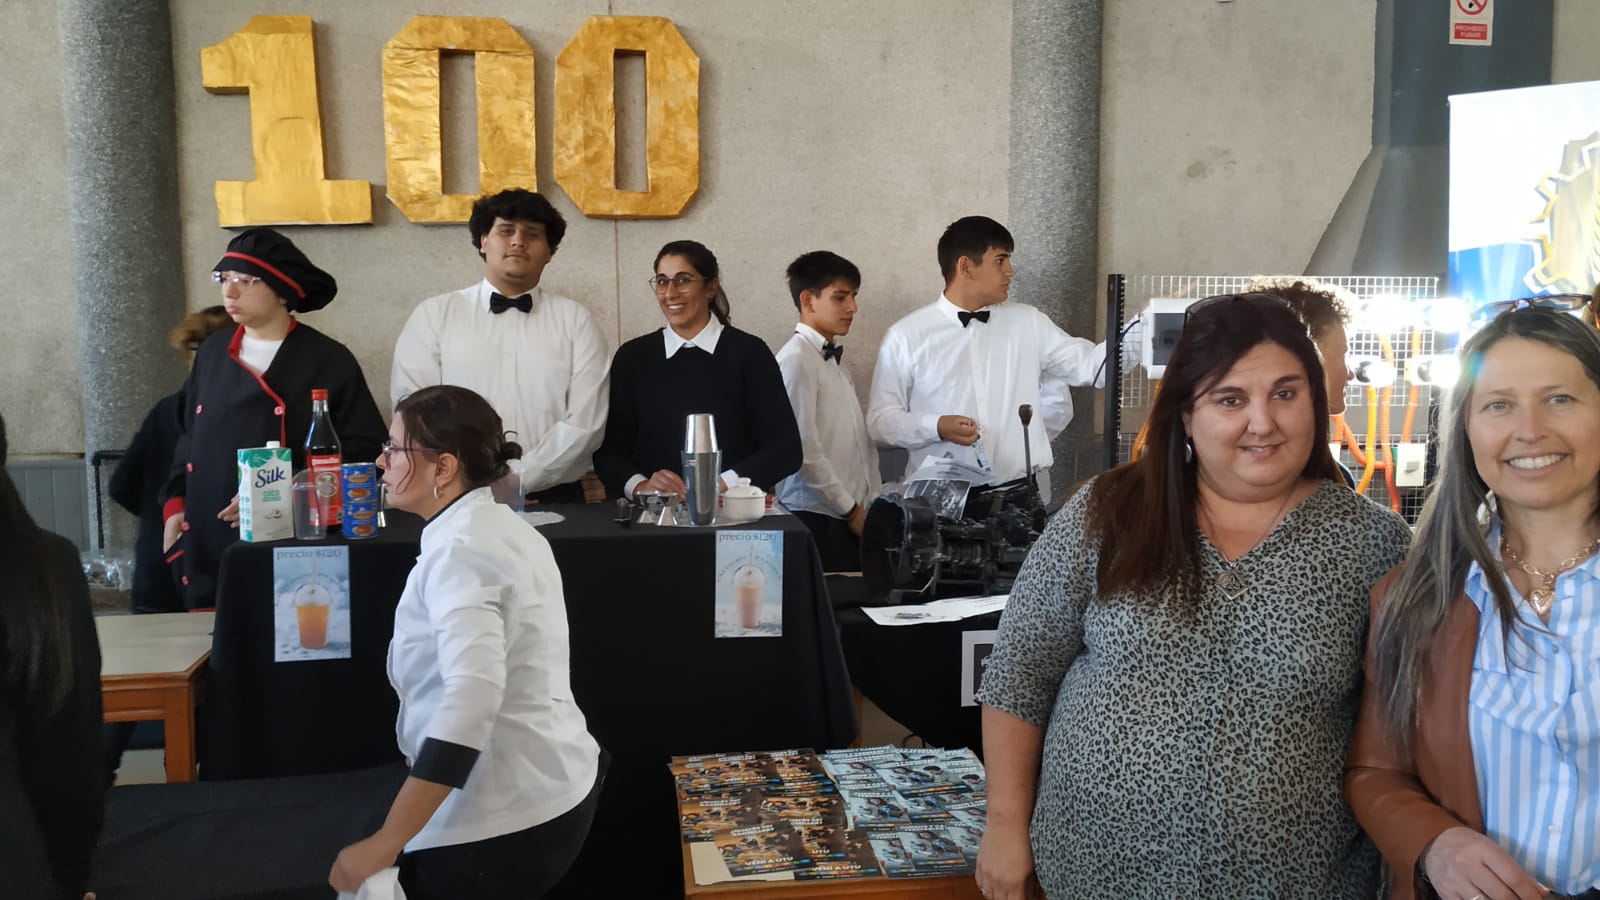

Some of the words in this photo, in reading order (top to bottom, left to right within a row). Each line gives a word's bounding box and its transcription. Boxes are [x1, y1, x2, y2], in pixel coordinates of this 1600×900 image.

[201, 15, 700, 228] 100
[255, 466, 286, 488] Silk
[719, 534, 751, 542] precio
[276, 549, 313, 560] precio
